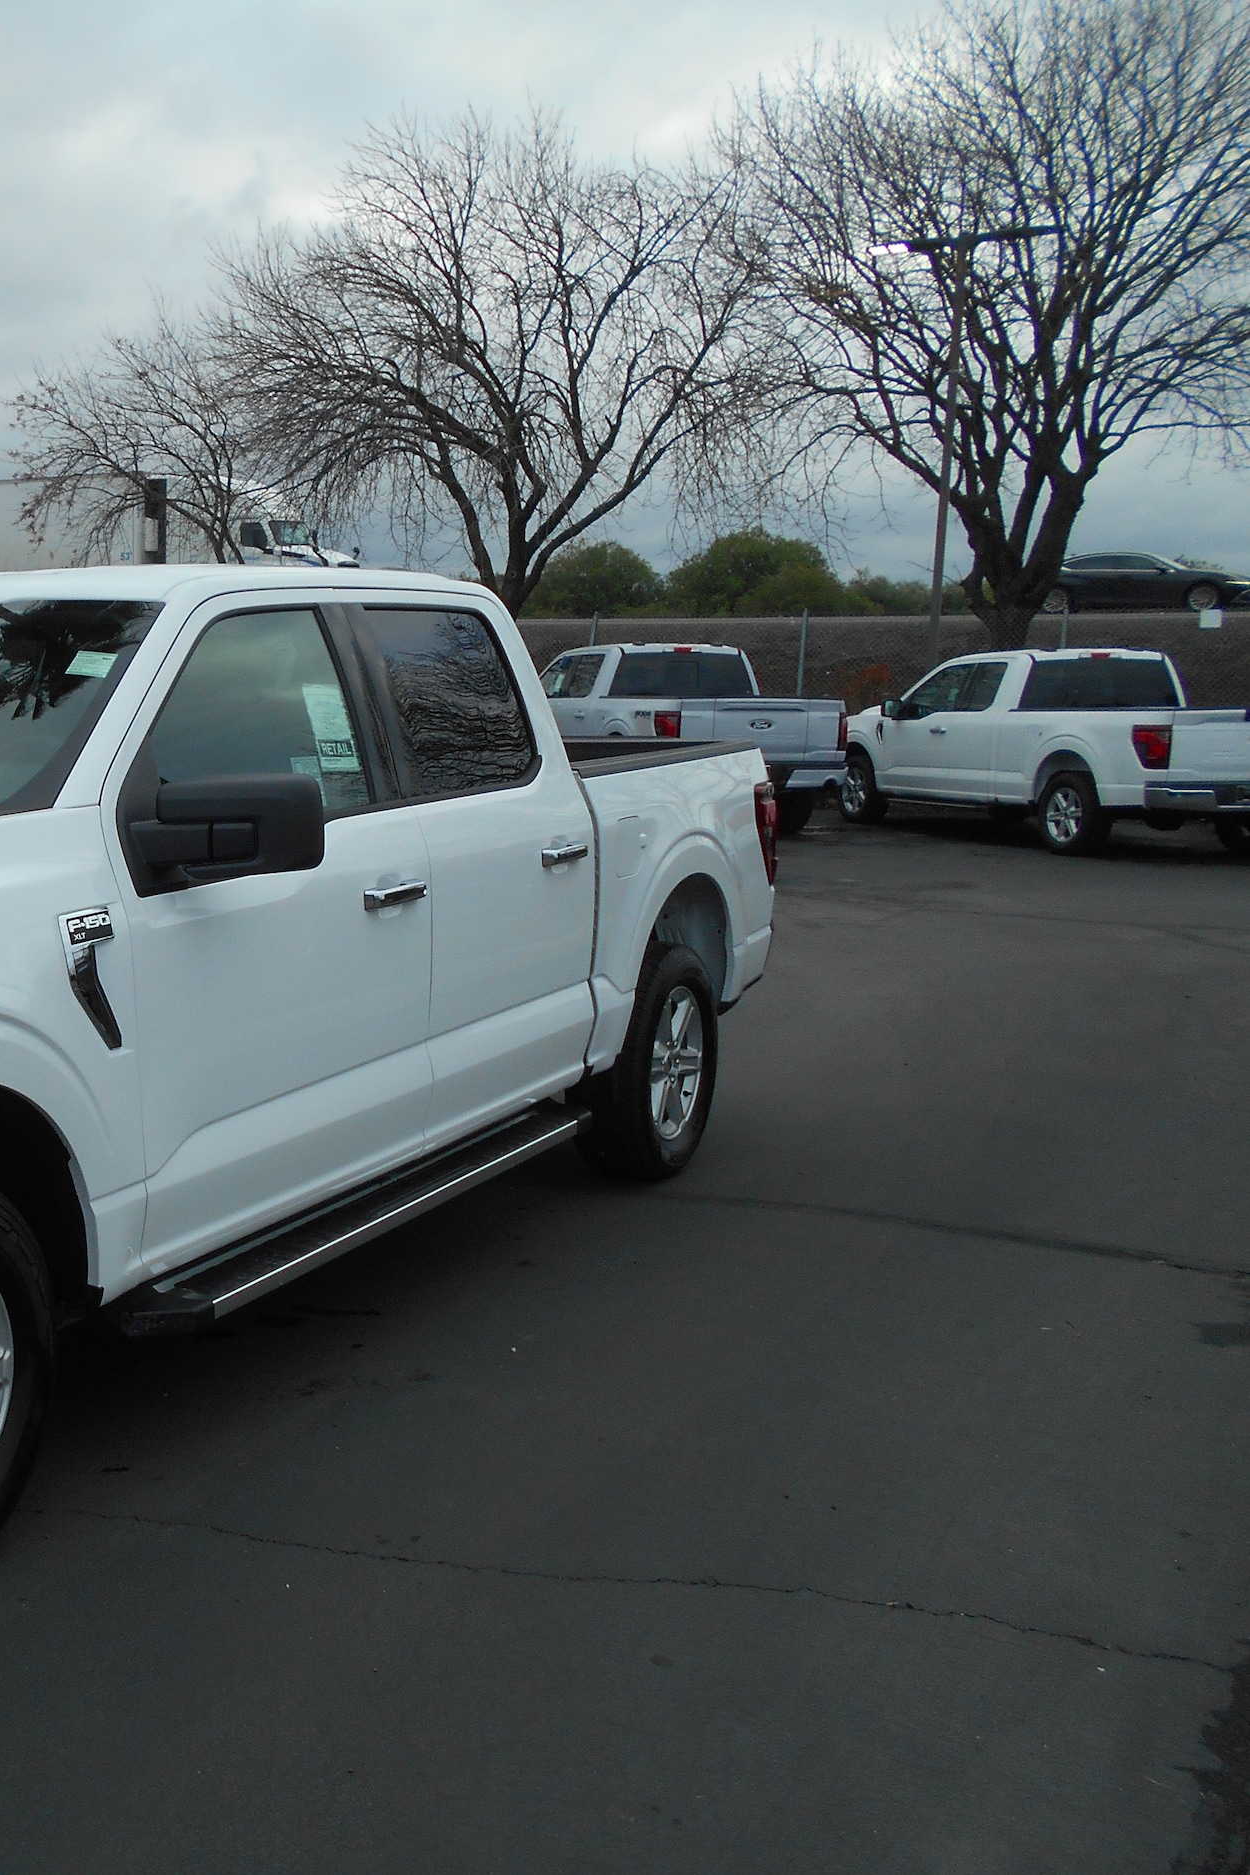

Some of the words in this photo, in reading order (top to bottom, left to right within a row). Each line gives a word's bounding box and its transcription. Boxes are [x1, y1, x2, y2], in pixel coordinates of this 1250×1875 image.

[321, 743, 352, 755] RETAIL
[68, 913, 111, 932] F-150
[73, 932, 87, 940] XLT
